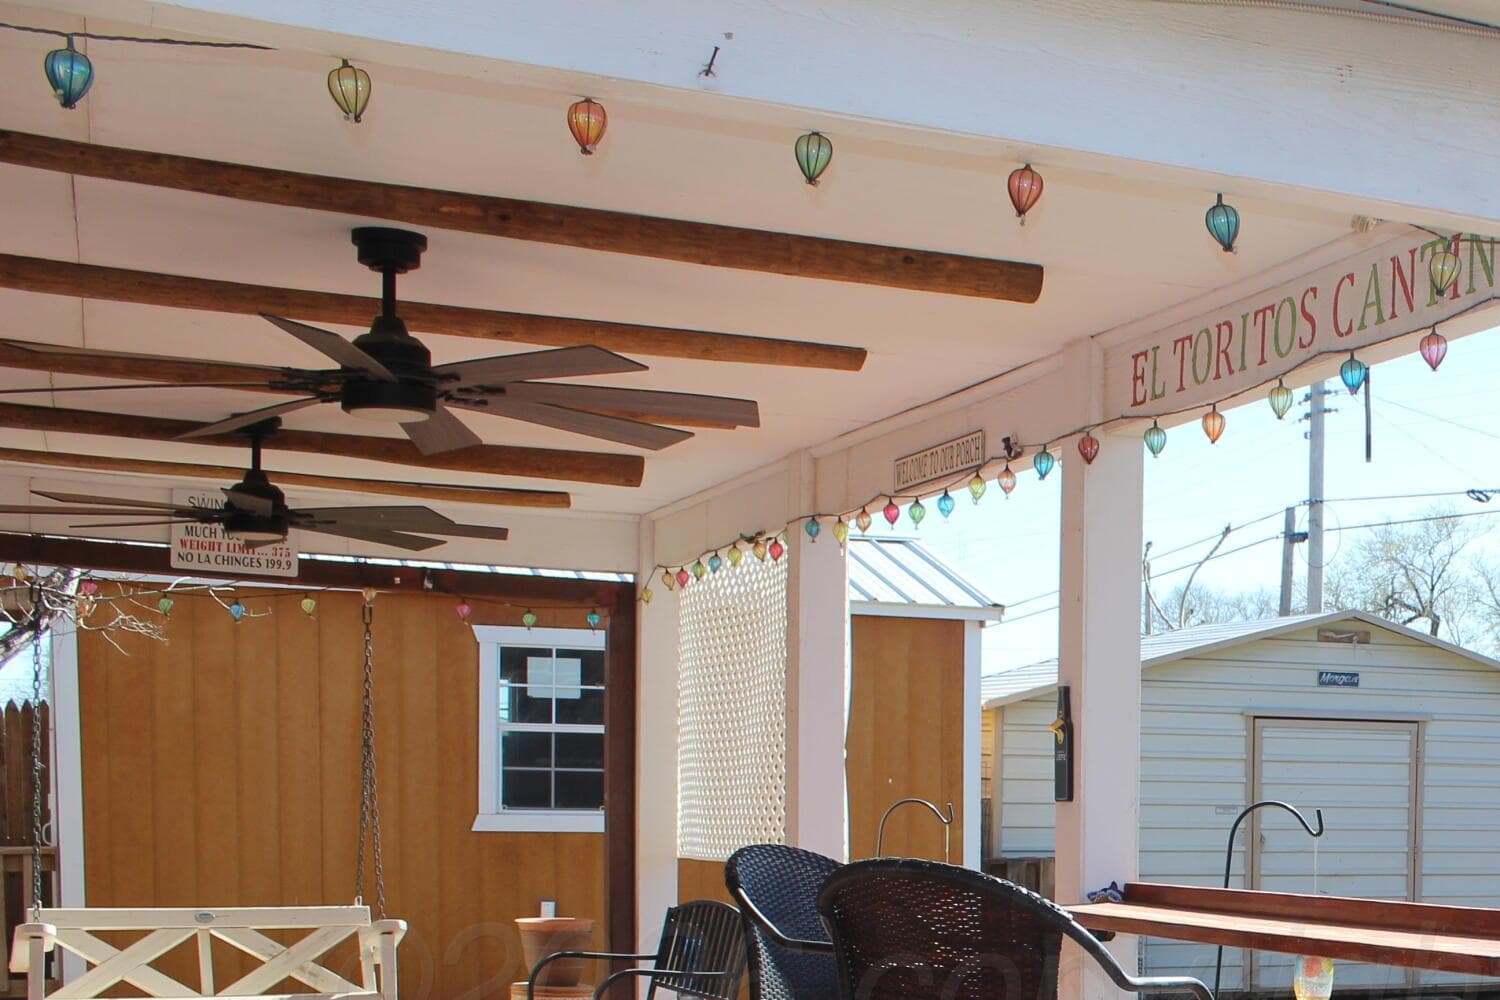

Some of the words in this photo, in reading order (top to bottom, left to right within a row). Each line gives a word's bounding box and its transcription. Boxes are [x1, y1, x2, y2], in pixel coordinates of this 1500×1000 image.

[1130, 345, 1168, 408] EL
[1172, 286, 1318, 393] TORITOS
[896, 453, 928, 486] WELCOME
[929, 450, 939, 476] TO
[940, 444, 955, 471] OUR
[956, 435, 981, 467] PORCH
[184, 525, 217, 539] MUCH
[179, 538, 223, 553] WEIGHT
[271, 546, 291, 558] 375
[177, 551, 194, 563] NO
[197, 553, 211, 565] LA
[214, 554, 262, 569] CHINGES
[265, 558, 292, 571] 199.9
[1319, 672, 1358, 685] Morgan
